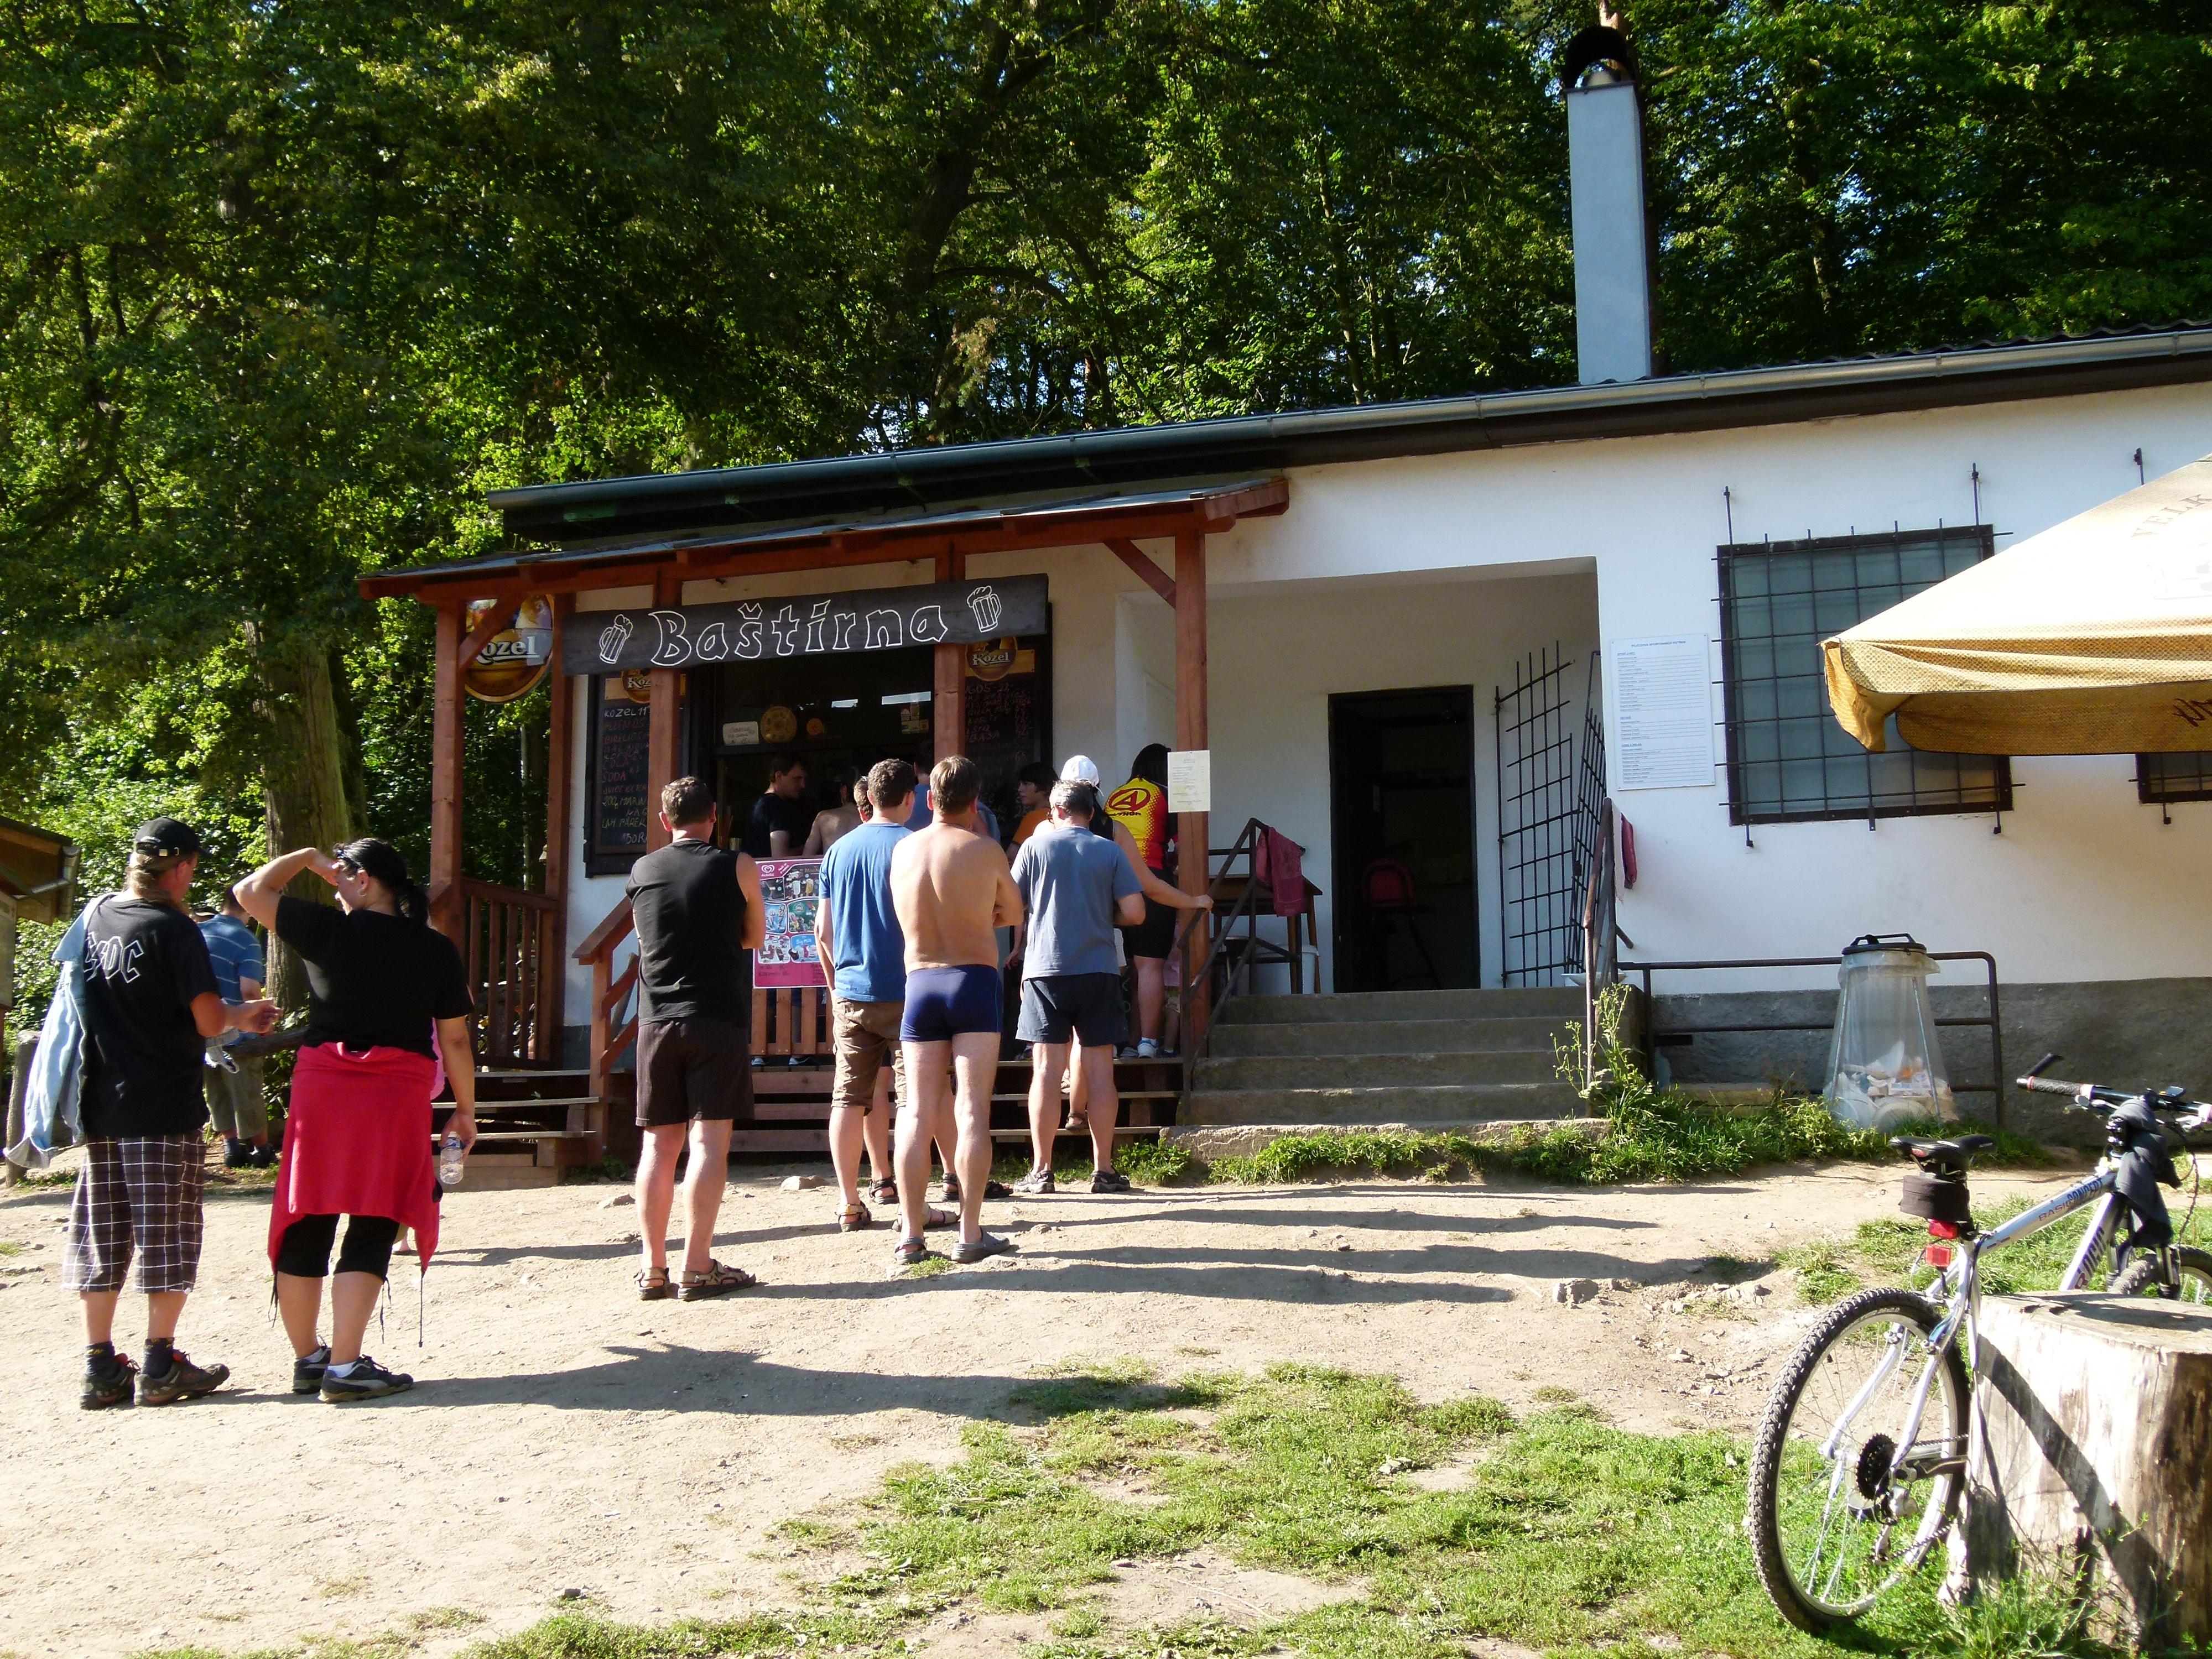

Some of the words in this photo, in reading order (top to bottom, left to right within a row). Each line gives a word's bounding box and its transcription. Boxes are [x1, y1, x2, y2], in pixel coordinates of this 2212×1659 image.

[648, 599, 949, 666] Baštírna
[476, 636, 540, 664] ozel
[972, 651, 1011, 666] Kozel
[627, 677, 650, 689] Koz
[83, 931, 144, 984] C/DC
